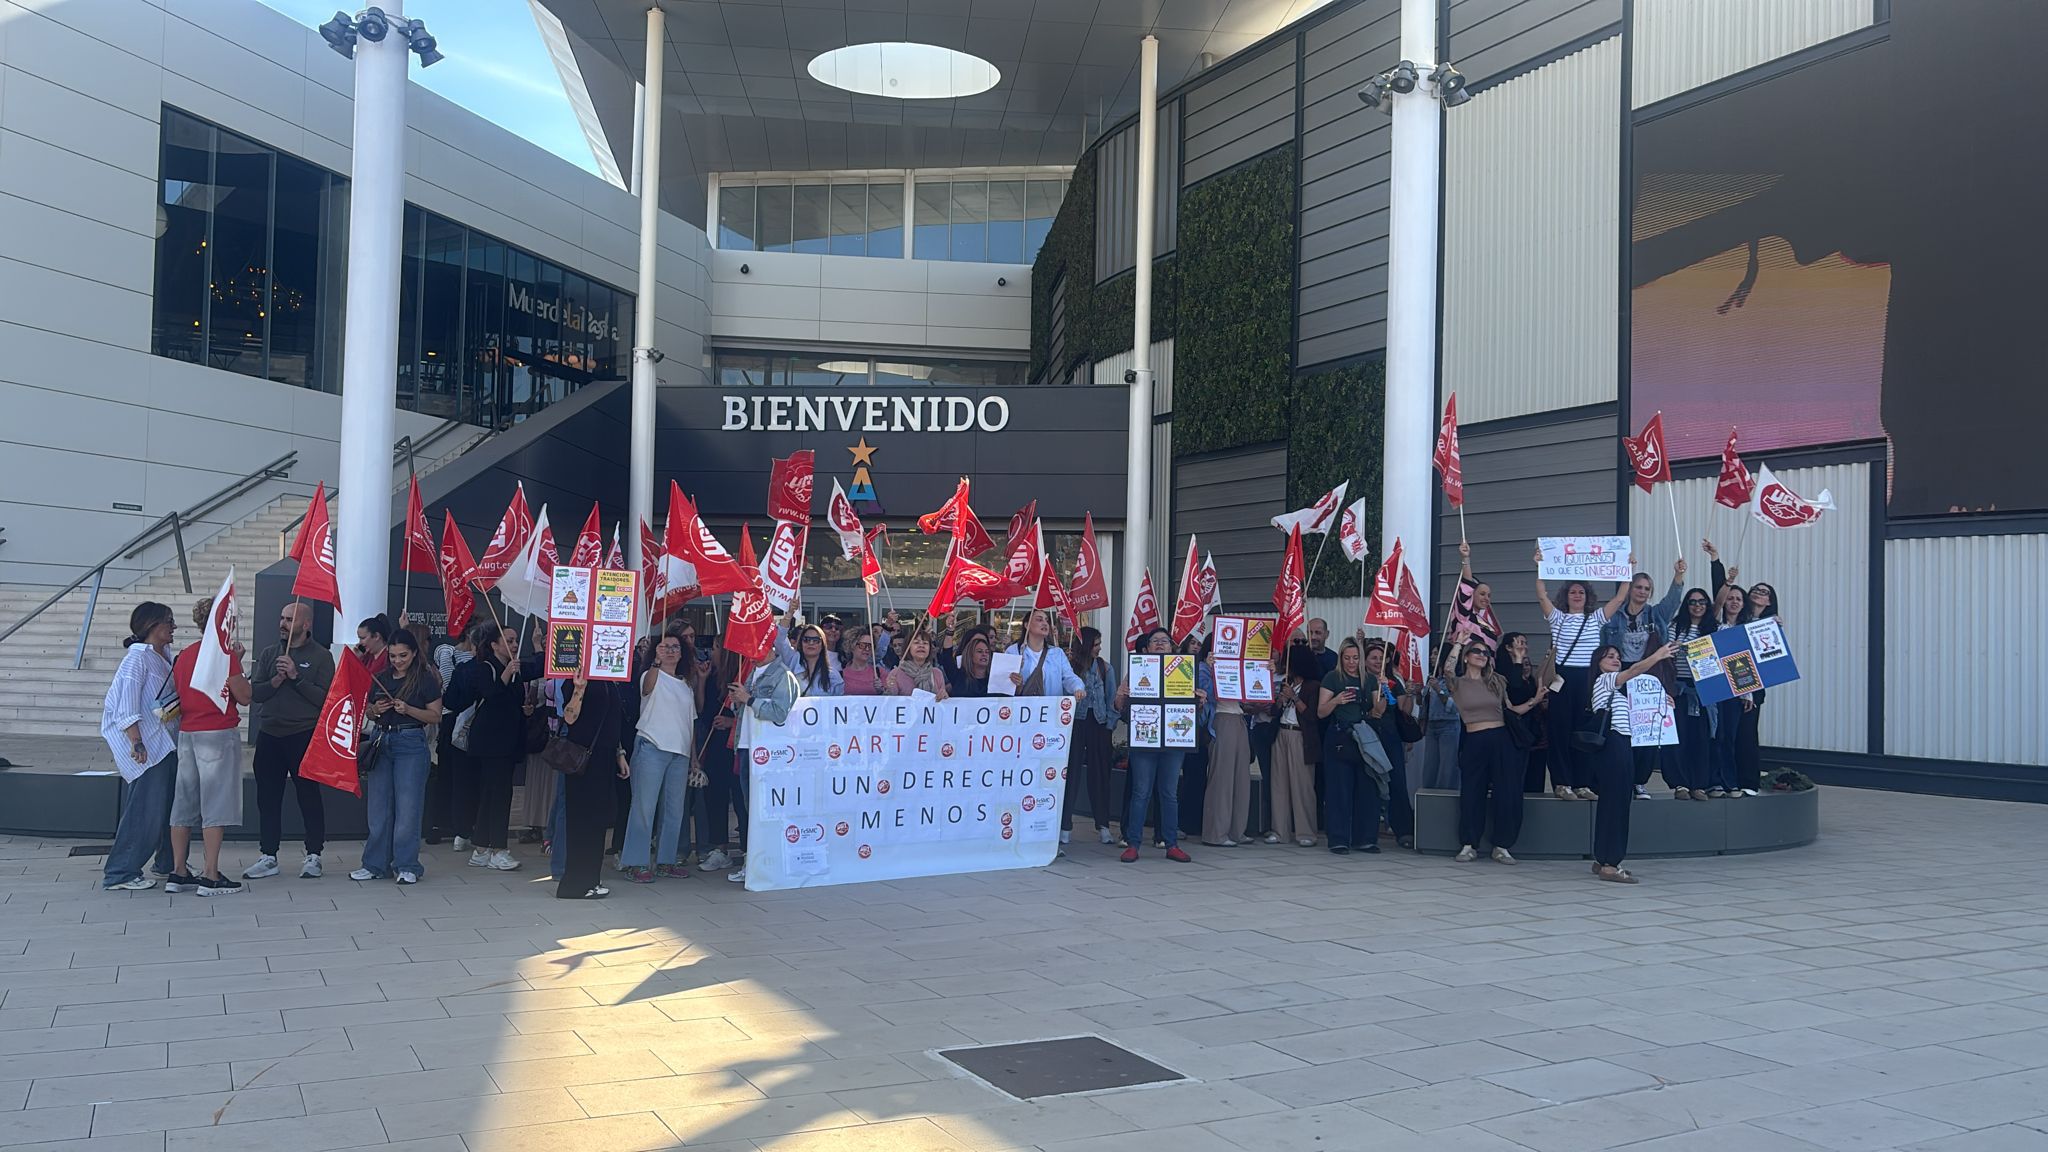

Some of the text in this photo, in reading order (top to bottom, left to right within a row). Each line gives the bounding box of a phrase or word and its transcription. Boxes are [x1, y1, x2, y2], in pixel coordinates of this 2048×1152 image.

[721, 395, 1010, 432] BIENVENIDO
[769, 526, 795, 577] UGT
[1565, 554, 1612, 564] QUITARNOS
[1558, 567, 1571, 575] QUE
[1575, 567, 1585, 575] ES
[331, 700, 354, 749] UGT
[1019, 705, 1049, 723] DE
[847, 734, 929, 754] ARTE
[967, 736, 1021, 759] ¡NO!
[771, 787, 801, 807] NI
[832, 775, 870, 796] UN
[903, 768, 1034, 790] DERECHO
[861, 804, 987, 830] MENOS
